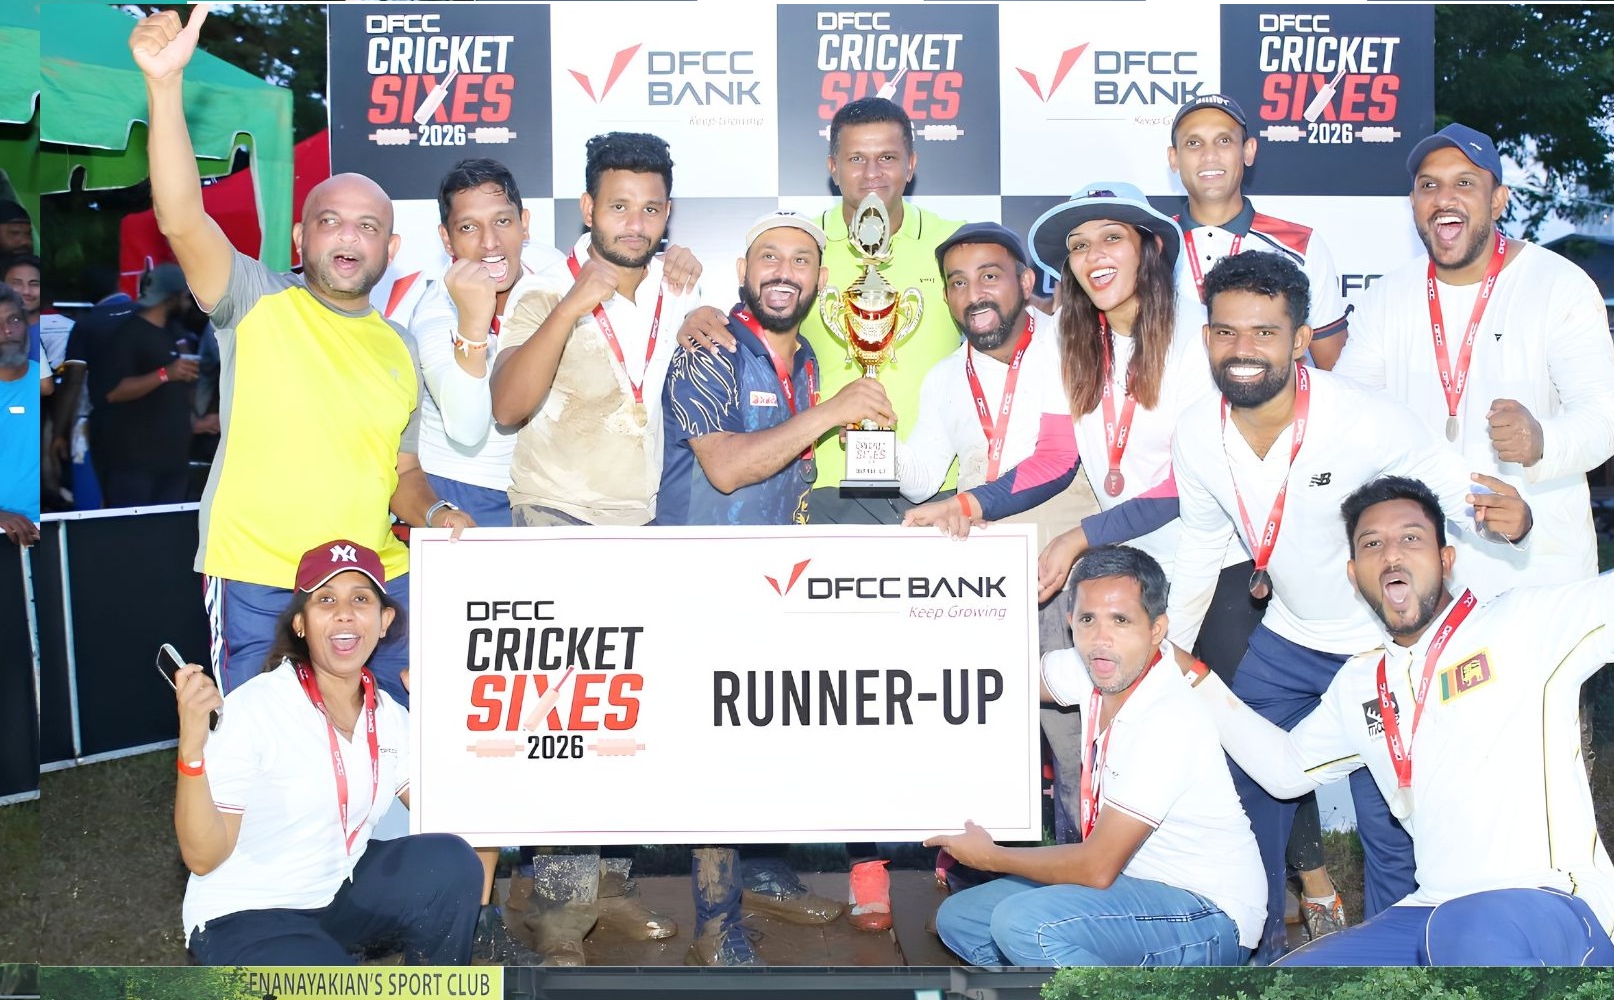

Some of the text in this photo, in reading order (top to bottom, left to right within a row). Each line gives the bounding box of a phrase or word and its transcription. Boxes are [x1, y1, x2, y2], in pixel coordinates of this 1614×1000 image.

[366, 14, 441, 34] DFCC
[817, 11, 890, 31] DFCC
[1259, 14, 1330, 33] DFCC
[367, 35, 515, 76] CRICKET
[648, 51, 754, 76] DFCC
[817, 34, 963, 72] CRICKET
[1094, 51, 1198, 76] DFCC
[1259, 36, 1400, 74] CRICKET
[367, 74, 515, 126] SIXES
[647, 81, 761, 106] BANK
[1094, 81, 1204, 105] BANK
[1258, 73, 1400, 122] SIXES
[418, 125, 467, 147] 2026
[1307, 123, 1353, 145] 2026
[807, 576, 1007, 599] DFCC BANK
[466, 601, 555, 621] DFCC
[909, 605, 1007, 620] Keep Growing
[466, 626, 644, 671] CRICKET
[466, 673, 644, 731] SIXES
[713, 668, 1004, 727] RUNNER-UP
[527, 735, 584, 759] 2026
[249, 972, 490, 996] ENANAYAKIAN'S SPORT CLUB
